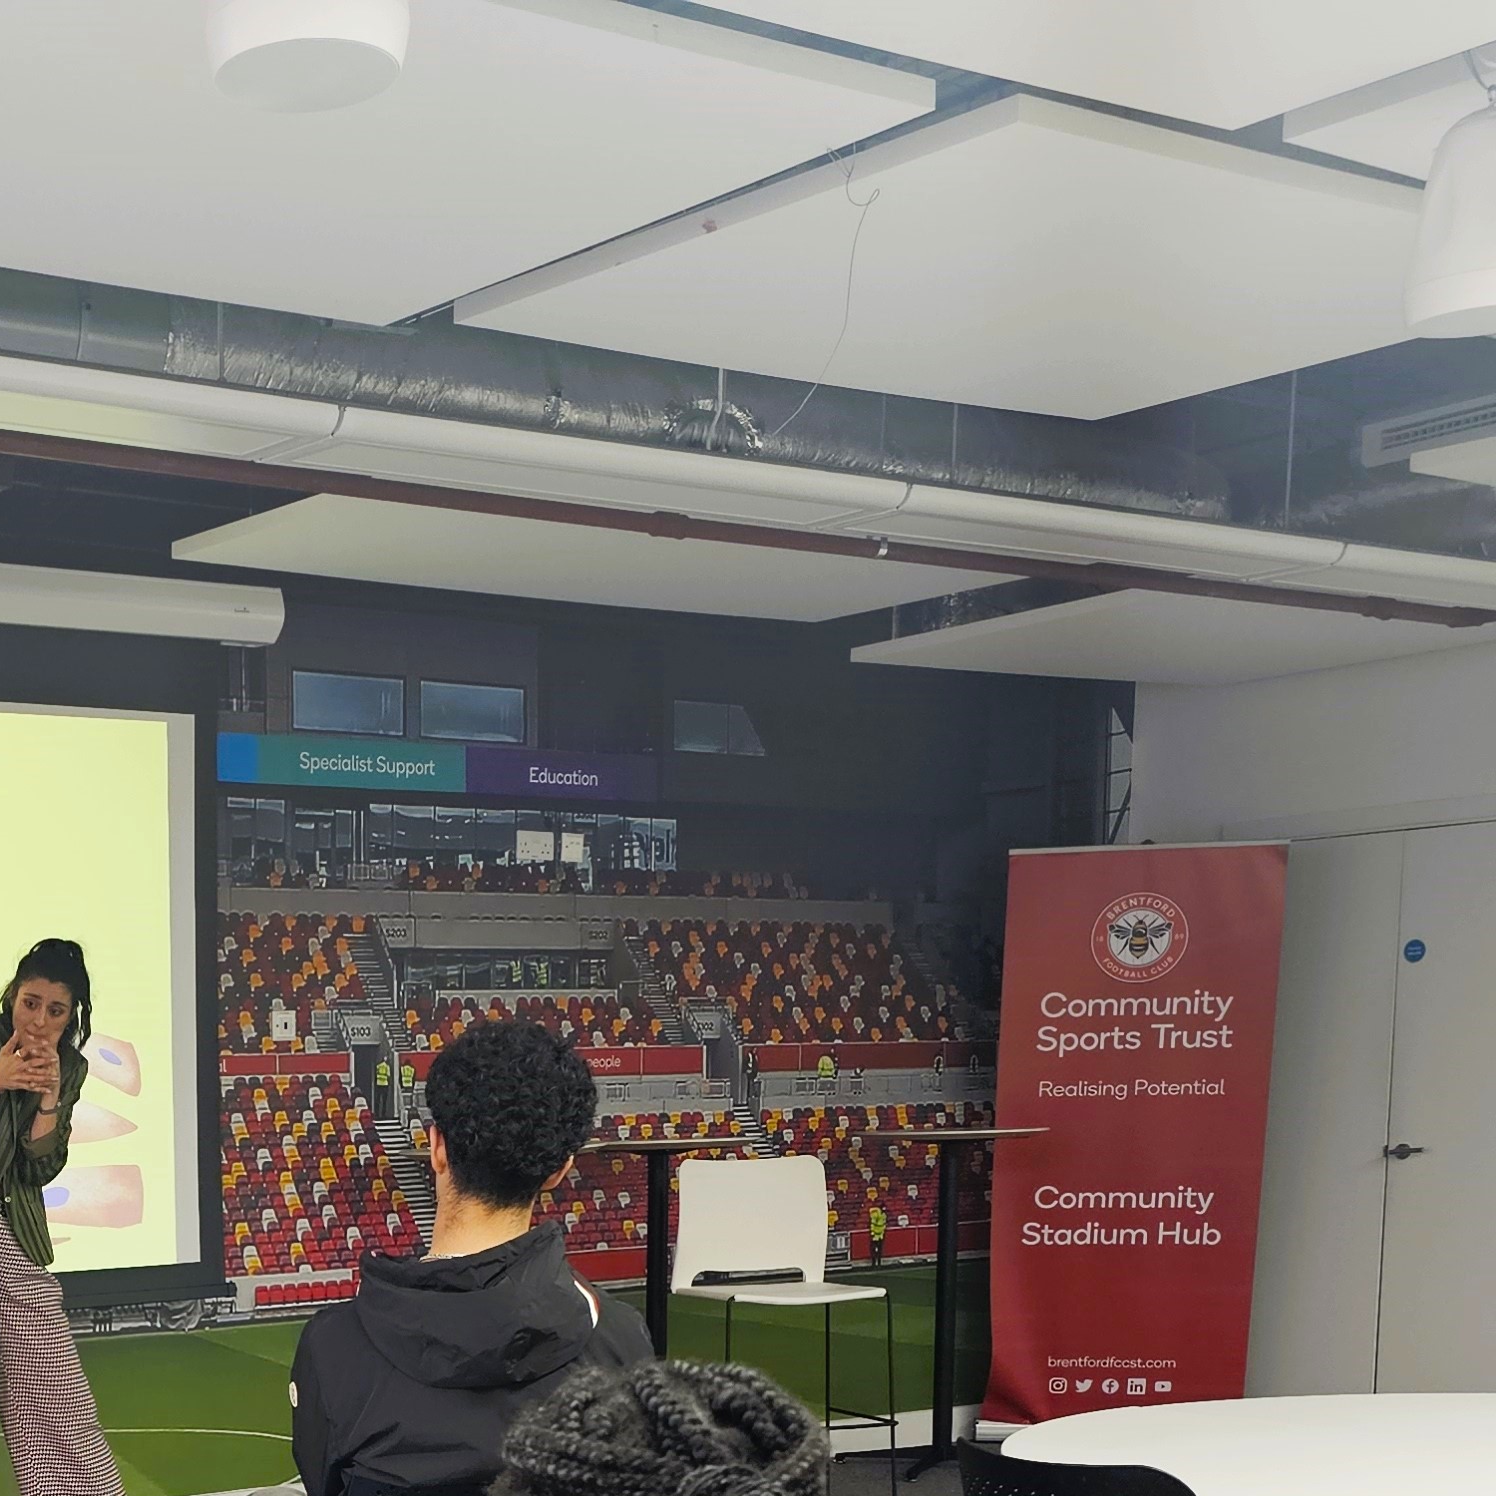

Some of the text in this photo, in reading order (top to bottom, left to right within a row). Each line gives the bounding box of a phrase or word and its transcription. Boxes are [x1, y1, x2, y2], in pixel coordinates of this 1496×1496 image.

[300, 752, 435, 778] Specialist Support
[529, 766, 598, 787] Education
[1106, 897, 1176, 920] BRENTFORD
[1103, 956, 1173, 978] FOOTBALL CLUB
[1041, 989, 1234, 1022] Community
[1036, 1023, 1233, 1058] Sports Trust
[1039, 1079, 1225, 1100] Realising Potential
[1034, 1185, 1214, 1214] Community
[1021, 1222, 1221, 1245] Stadium Hub
[1048, 1356, 1176, 1369] brentfordfccst.com
